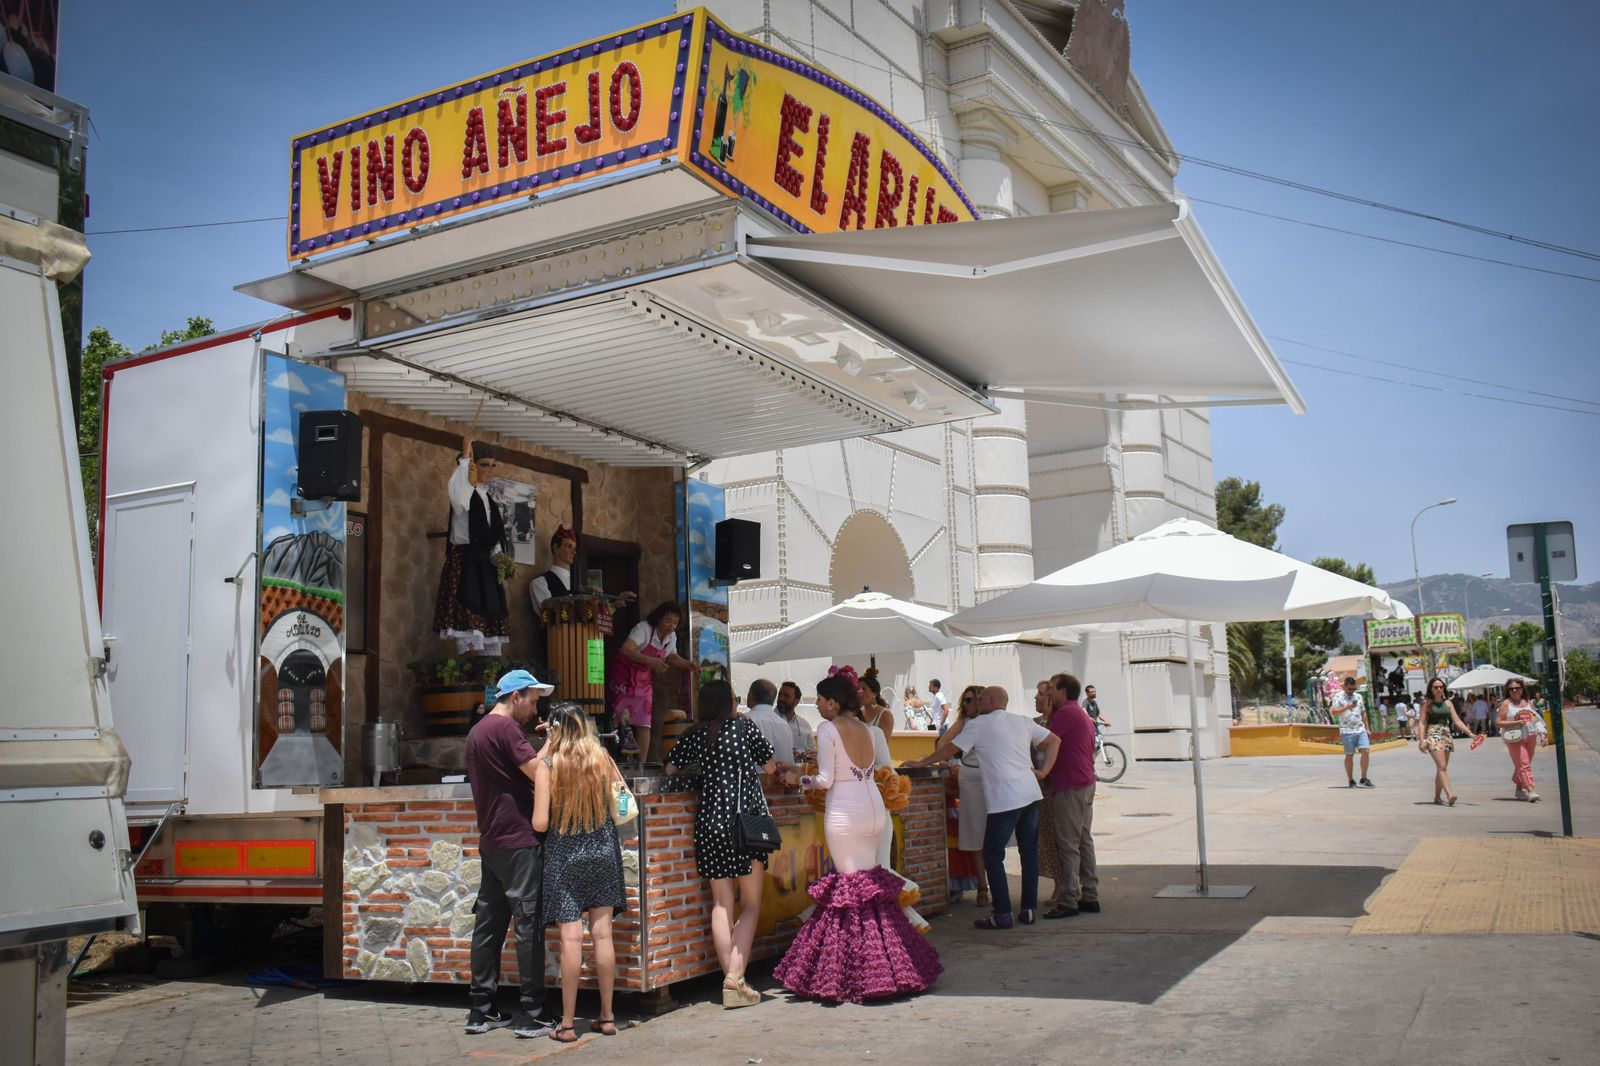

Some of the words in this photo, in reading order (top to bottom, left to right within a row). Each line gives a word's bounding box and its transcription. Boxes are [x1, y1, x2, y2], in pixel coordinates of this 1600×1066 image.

[317, 127, 430, 220] VINO
[462, 60, 642, 181] AÑEJO
[1373, 626, 1411, 639] BODEGA
[1430, 622, 1458, 636] VINO
